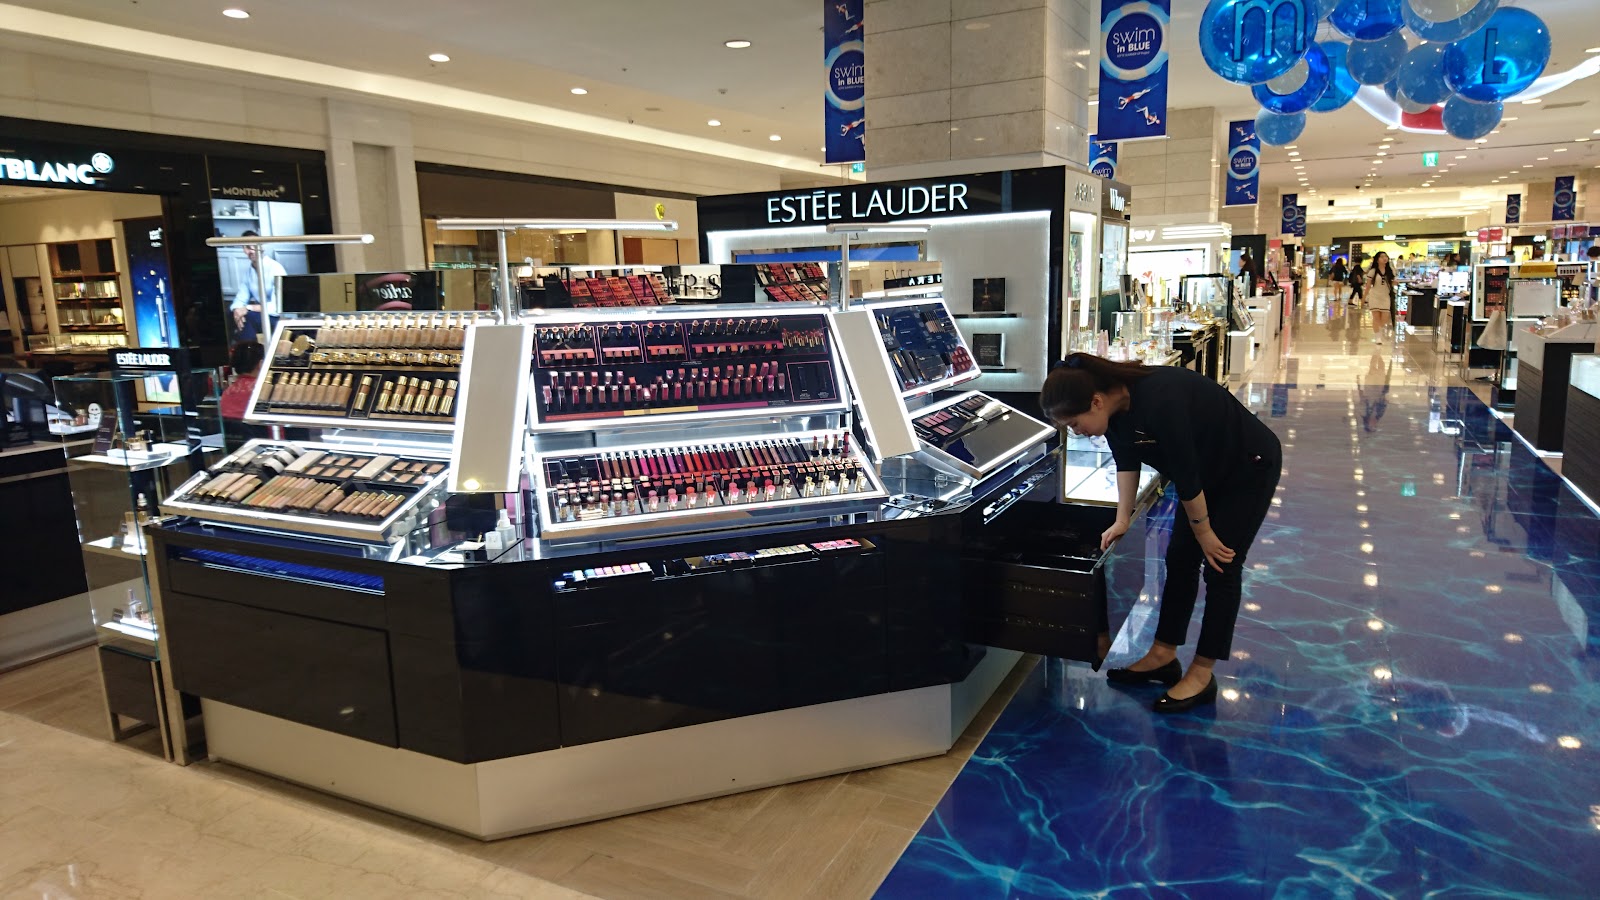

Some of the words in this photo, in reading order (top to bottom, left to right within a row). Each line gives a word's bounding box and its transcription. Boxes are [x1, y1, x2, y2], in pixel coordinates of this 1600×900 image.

[1112, 27, 1156, 45] swim
[1116, 45, 1126, 53] in
[1128, 41, 1151, 52] BLUE
[1233, 156, 1254, 165] swim
[222, 187, 279, 198] MONTBLANC
[851, 183, 969, 218] LAUDER
[139, 353, 171, 366] LAUDER
